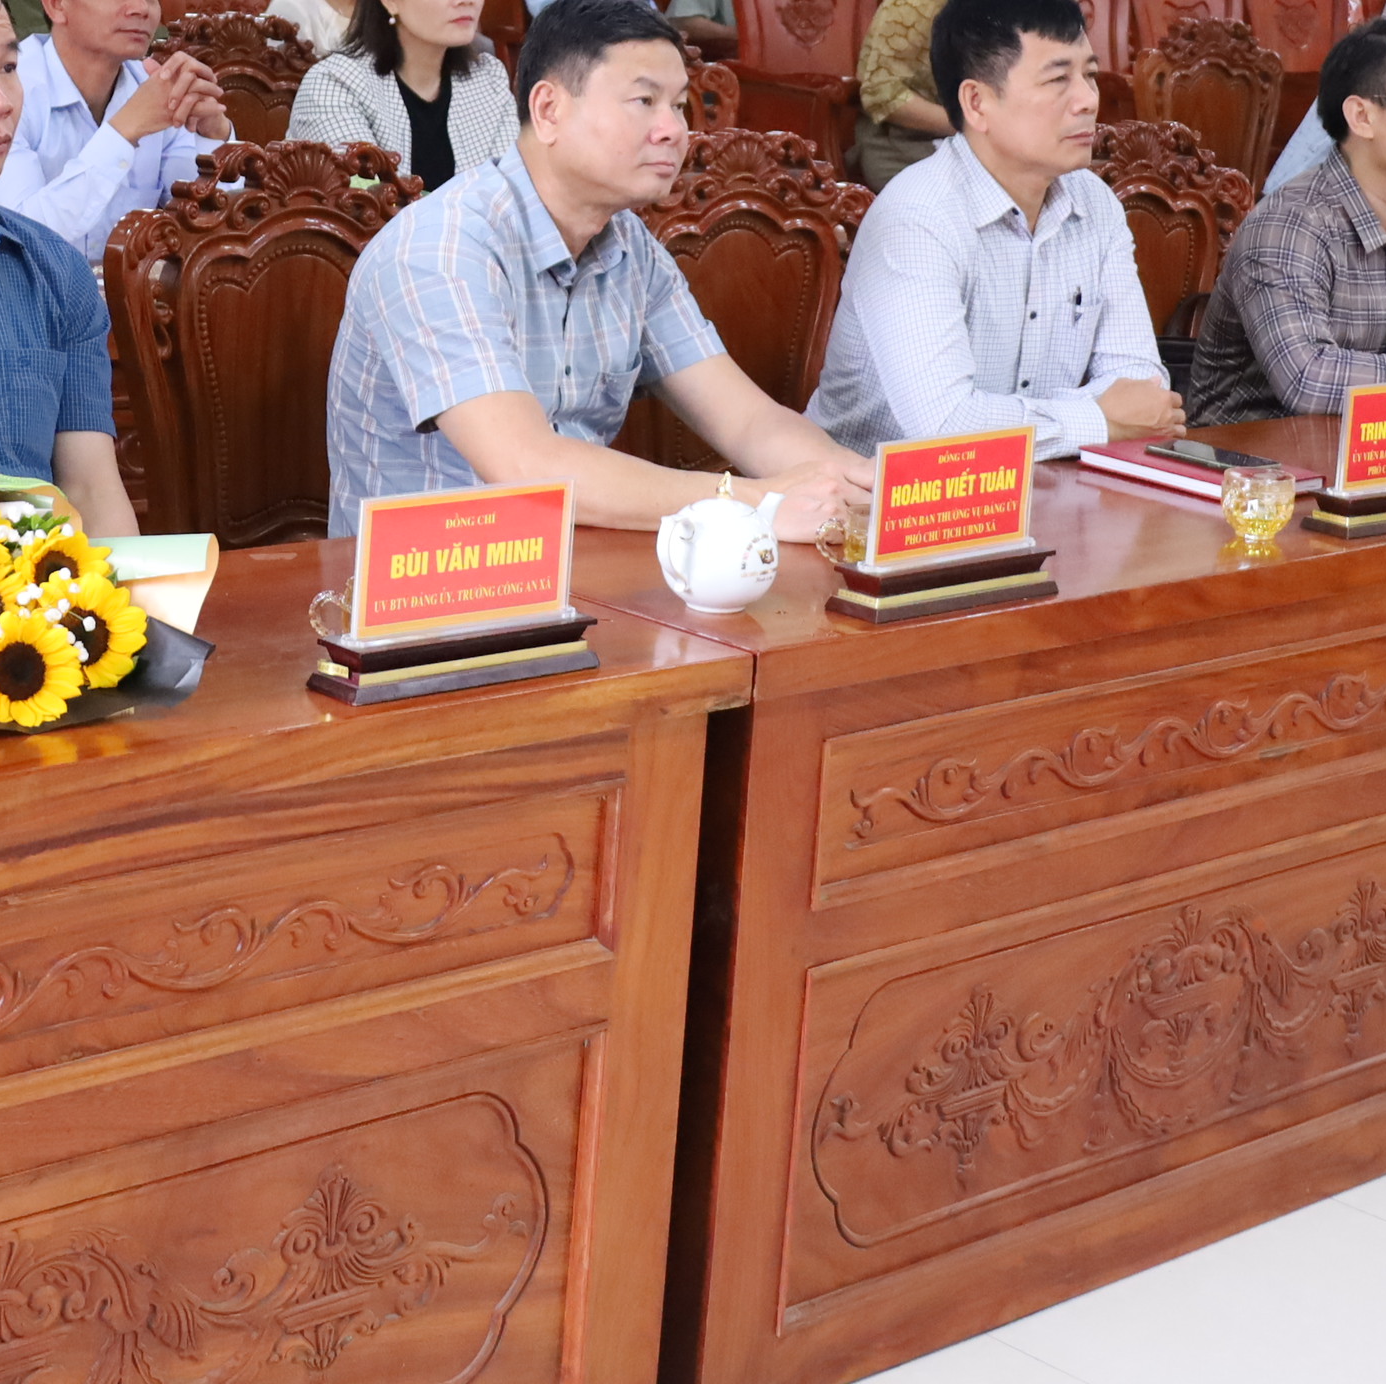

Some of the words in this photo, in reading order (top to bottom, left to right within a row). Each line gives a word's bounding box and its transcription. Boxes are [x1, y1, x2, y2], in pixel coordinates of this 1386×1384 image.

[890, 477, 942, 508] HOÀNG
[945, 467, 977, 499] VIẾT
[445, 513, 475, 530] ĐỒNG
[477, 511, 497, 525] CHÍ
[898, 514, 918, 529] VIÊN
[918, 513, 936, 526] BAN
[904, 530, 923, 546] PHÓ
[390, 547, 429, 580] BÙI
[436, 542, 480, 574] VĂN
[485, 536, 544, 567] MINH
[374, 600, 389, 614] UV
[389, 596, 410, 612] BTV
[497, 580, 524, 597] CÔNG
[524, 578, 538, 593] AN
